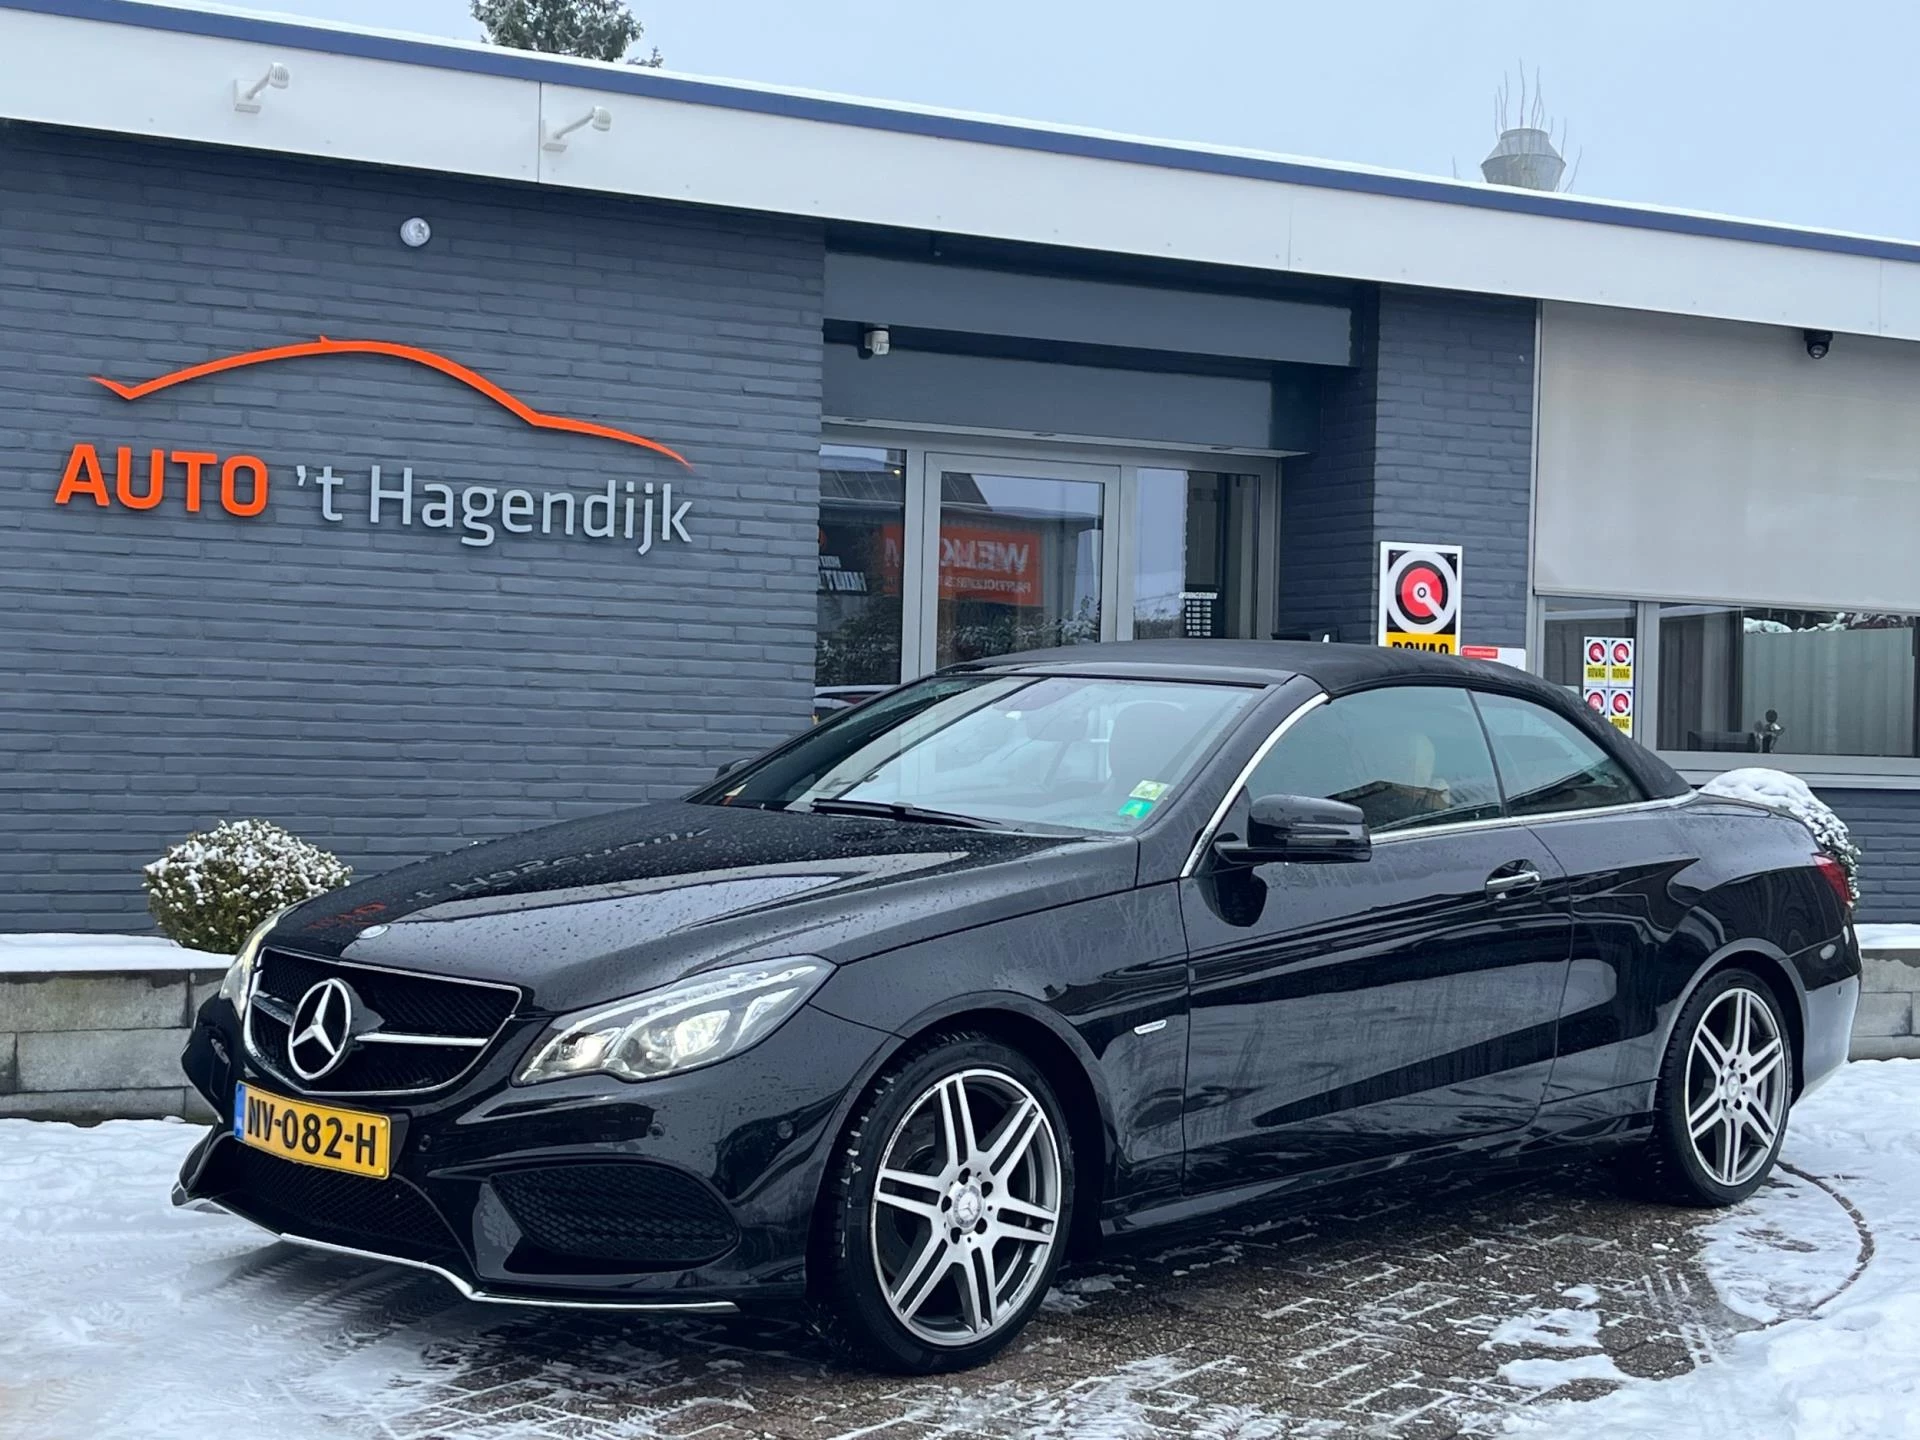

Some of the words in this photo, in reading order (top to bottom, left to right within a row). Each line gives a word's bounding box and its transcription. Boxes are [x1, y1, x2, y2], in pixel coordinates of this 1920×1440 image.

[55, 443, 268, 517] AUTO
[369, 465, 693, 555] Hagendijk
[248, 1096, 376, 1166] NV-082-H
